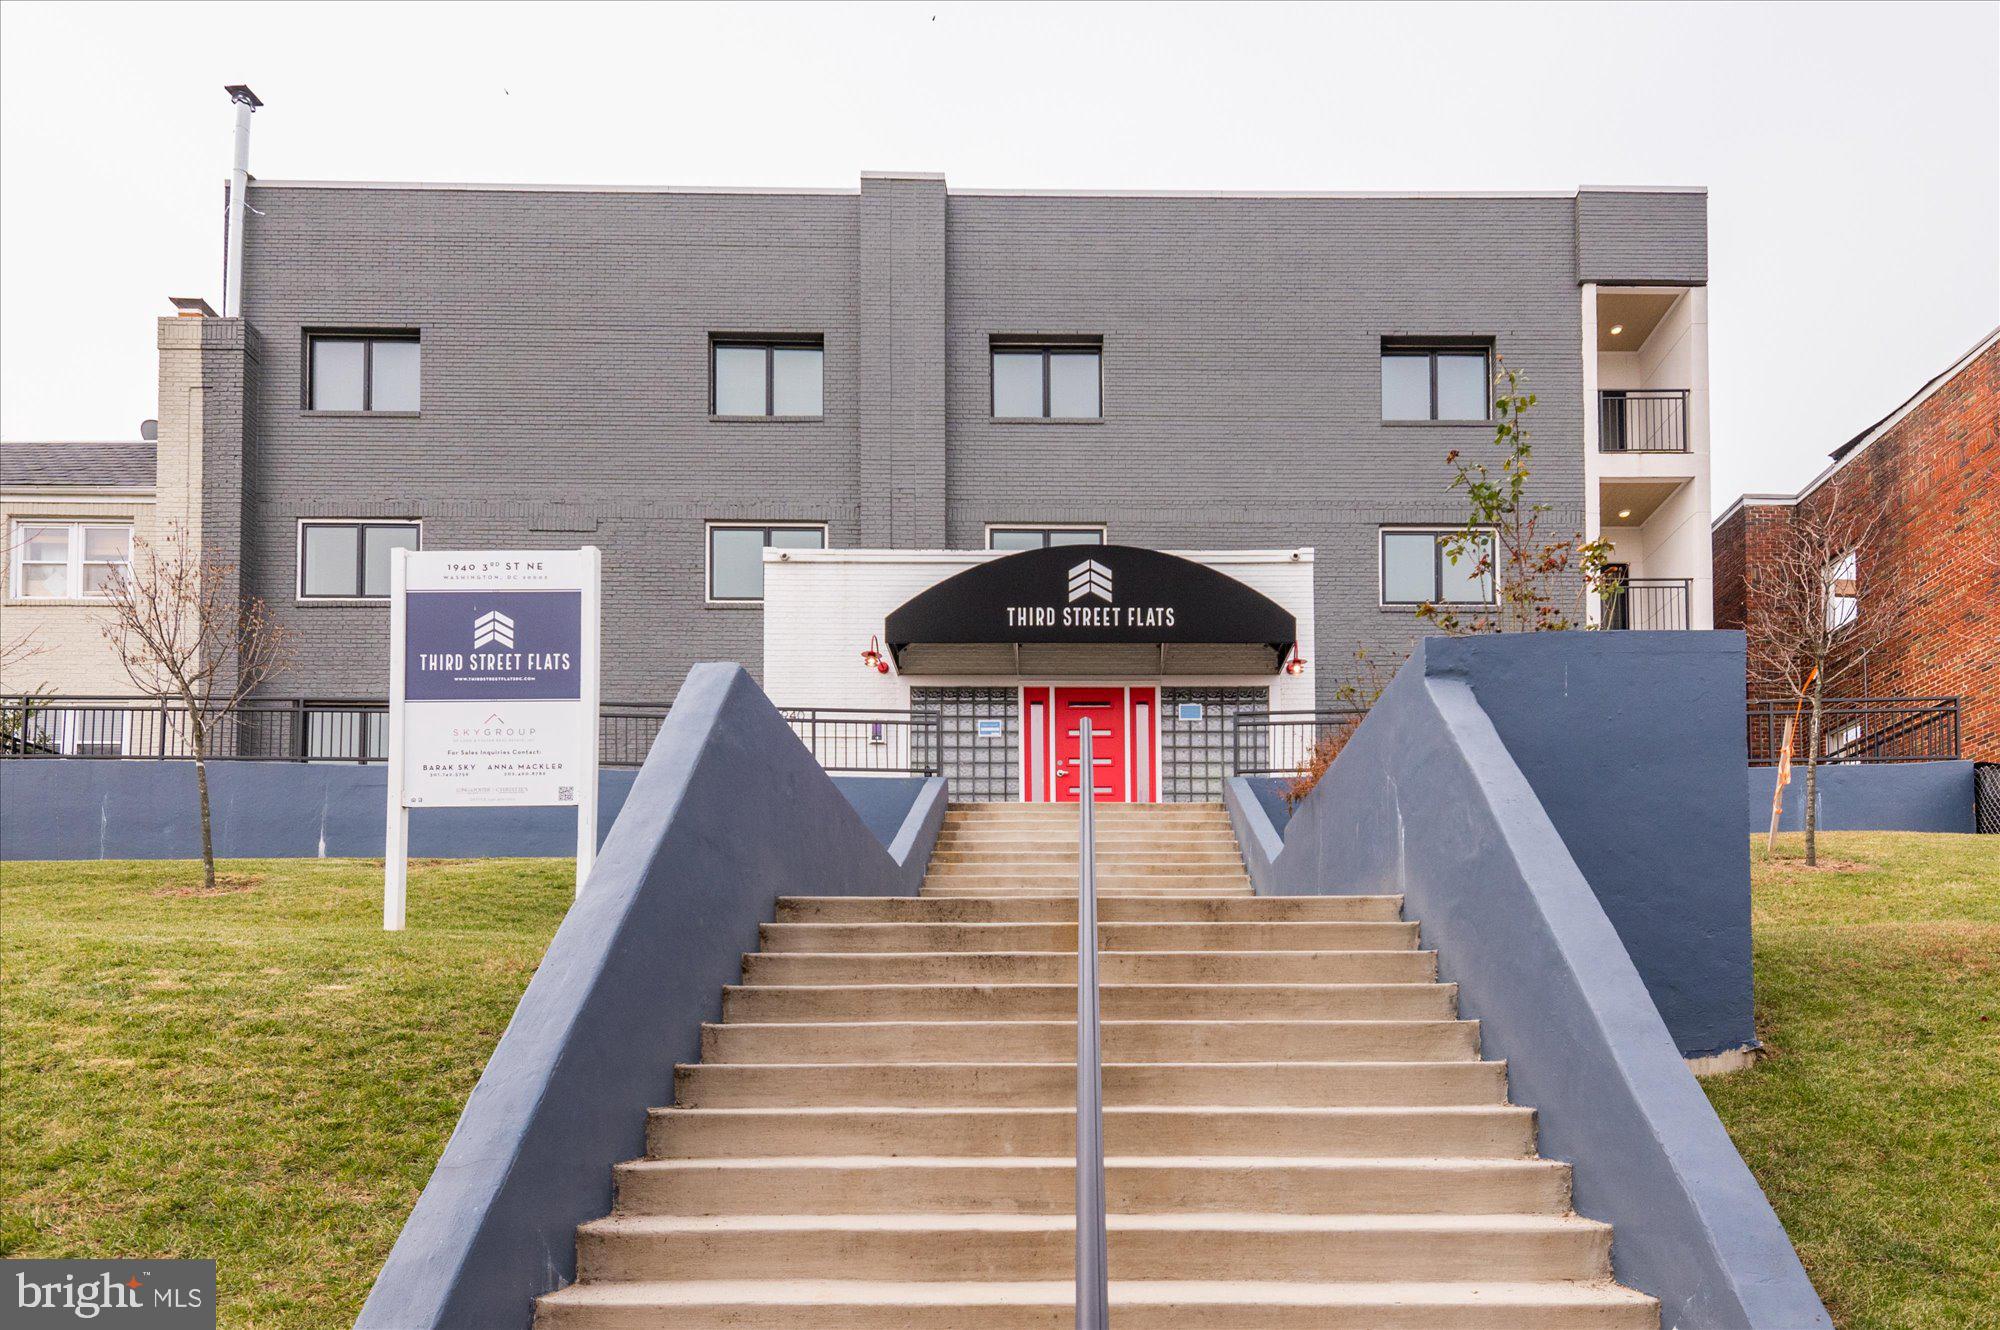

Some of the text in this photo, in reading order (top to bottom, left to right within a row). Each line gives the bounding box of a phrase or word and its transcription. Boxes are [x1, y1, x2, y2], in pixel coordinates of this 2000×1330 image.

[505, 562, 520, 571] ST
[527, 562, 543, 571] NE
[1007, 607, 1175, 627] THIRD STREET FLATS
[420, 653, 571, 671] THIRD STREET FLATS
